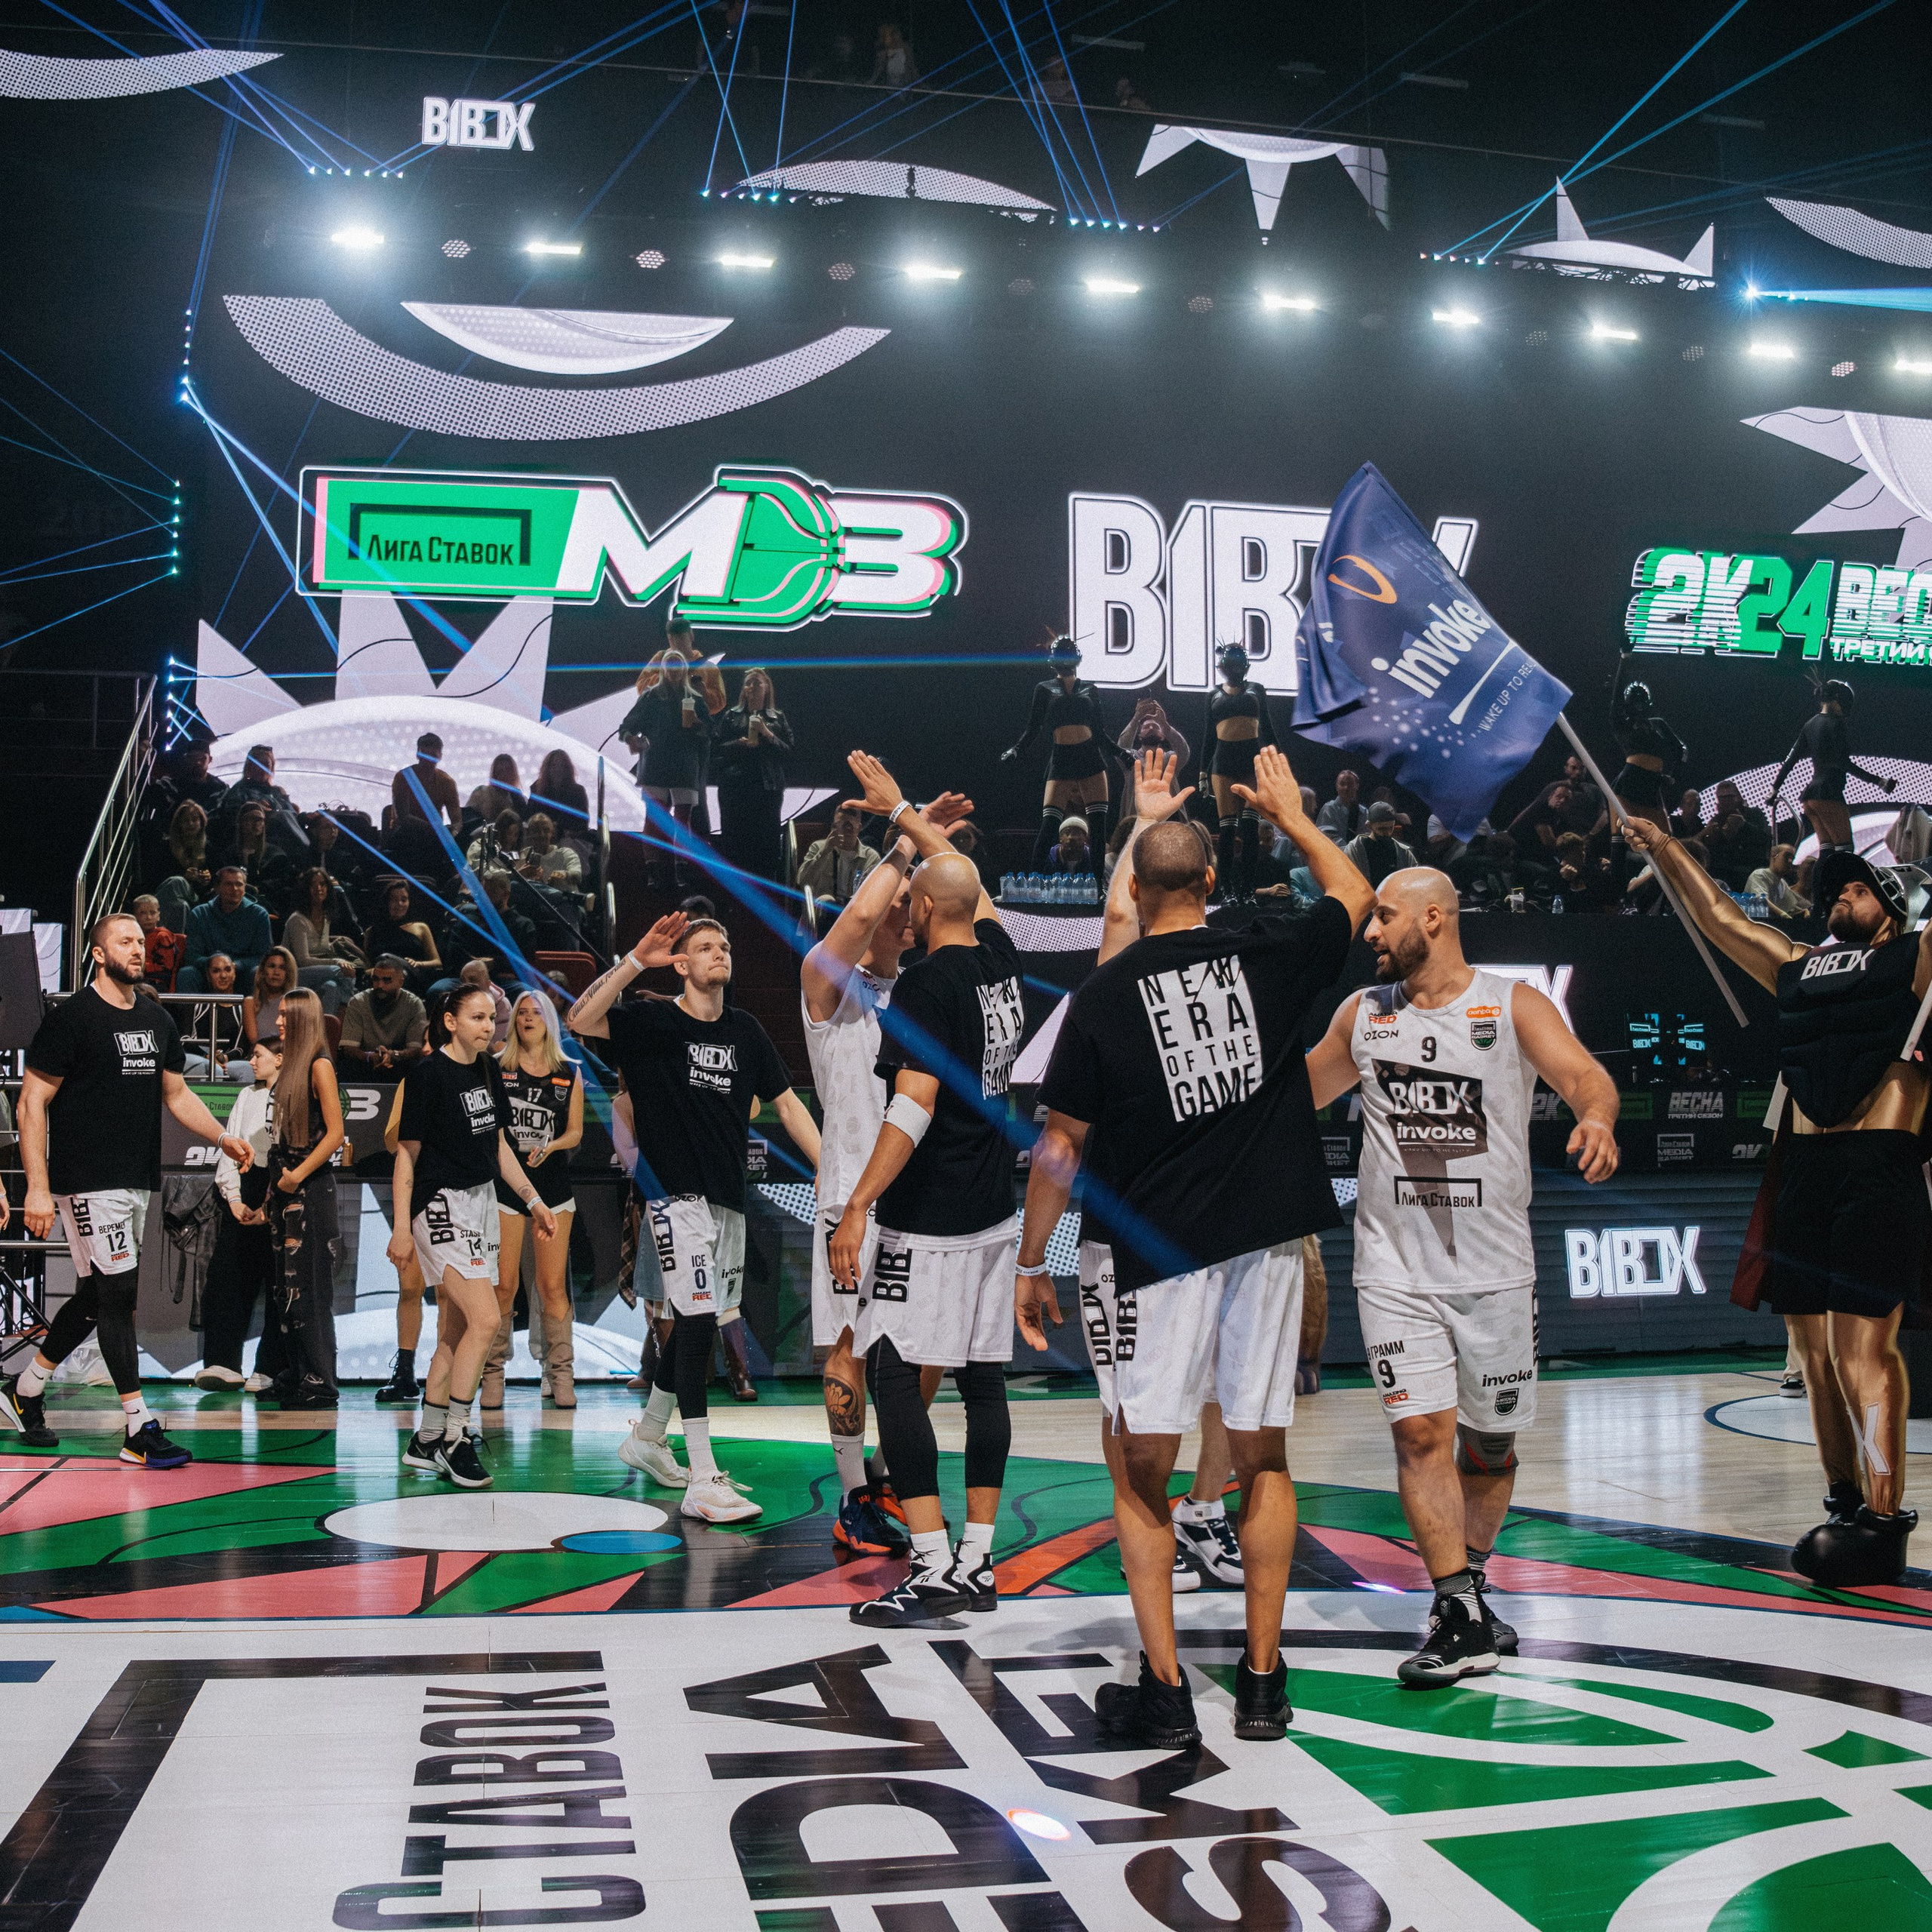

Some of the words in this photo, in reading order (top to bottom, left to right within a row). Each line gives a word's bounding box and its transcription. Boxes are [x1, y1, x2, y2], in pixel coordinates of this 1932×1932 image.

[1068, 491, 1478, 696] BIB
[1371, 599, 1491, 699] invoke
[1497, 690, 1511, 706] UP
[1507, 676, 1523, 691] TO
[1153, 992, 1249, 1050] ERA
[1368, 1015, 1397, 1024] RED
[1364, 1029, 1399, 1041] OZON
[984, 1047, 1001, 1066] OF
[1166, 1050, 1195, 1077] OF
[1205, 1035, 1255, 1066] THE
[1420, 1035, 1437, 1063] 9
[123, 1057, 155, 1068] invoke
[690, 1066, 731, 1086] invoke
[983, 1060, 1011, 1099] GAM
[528, 1088, 543, 1102] 17
[1669, 1091, 1724, 1114] ВЕСНА
[1396, 1122, 1476, 1141] invoke
[106, 1231, 127, 1252] 12
[111, 1253, 130, 1262] RED
[691, 1254, 706, 1267] ICE
[1101, 1274, 1115, 1283] OZ
[1371, 1340, 1405, 1359] ГРАММ
[1378, 1359, 1396, 1389] 9
[1481, 1370, 1533, 1387] invoke
[1383, 1393, 1409, 1405] RED
[683, 1643, 1091, 1932] DIA
[333, 1681, 648, 1932] СТАВОК
